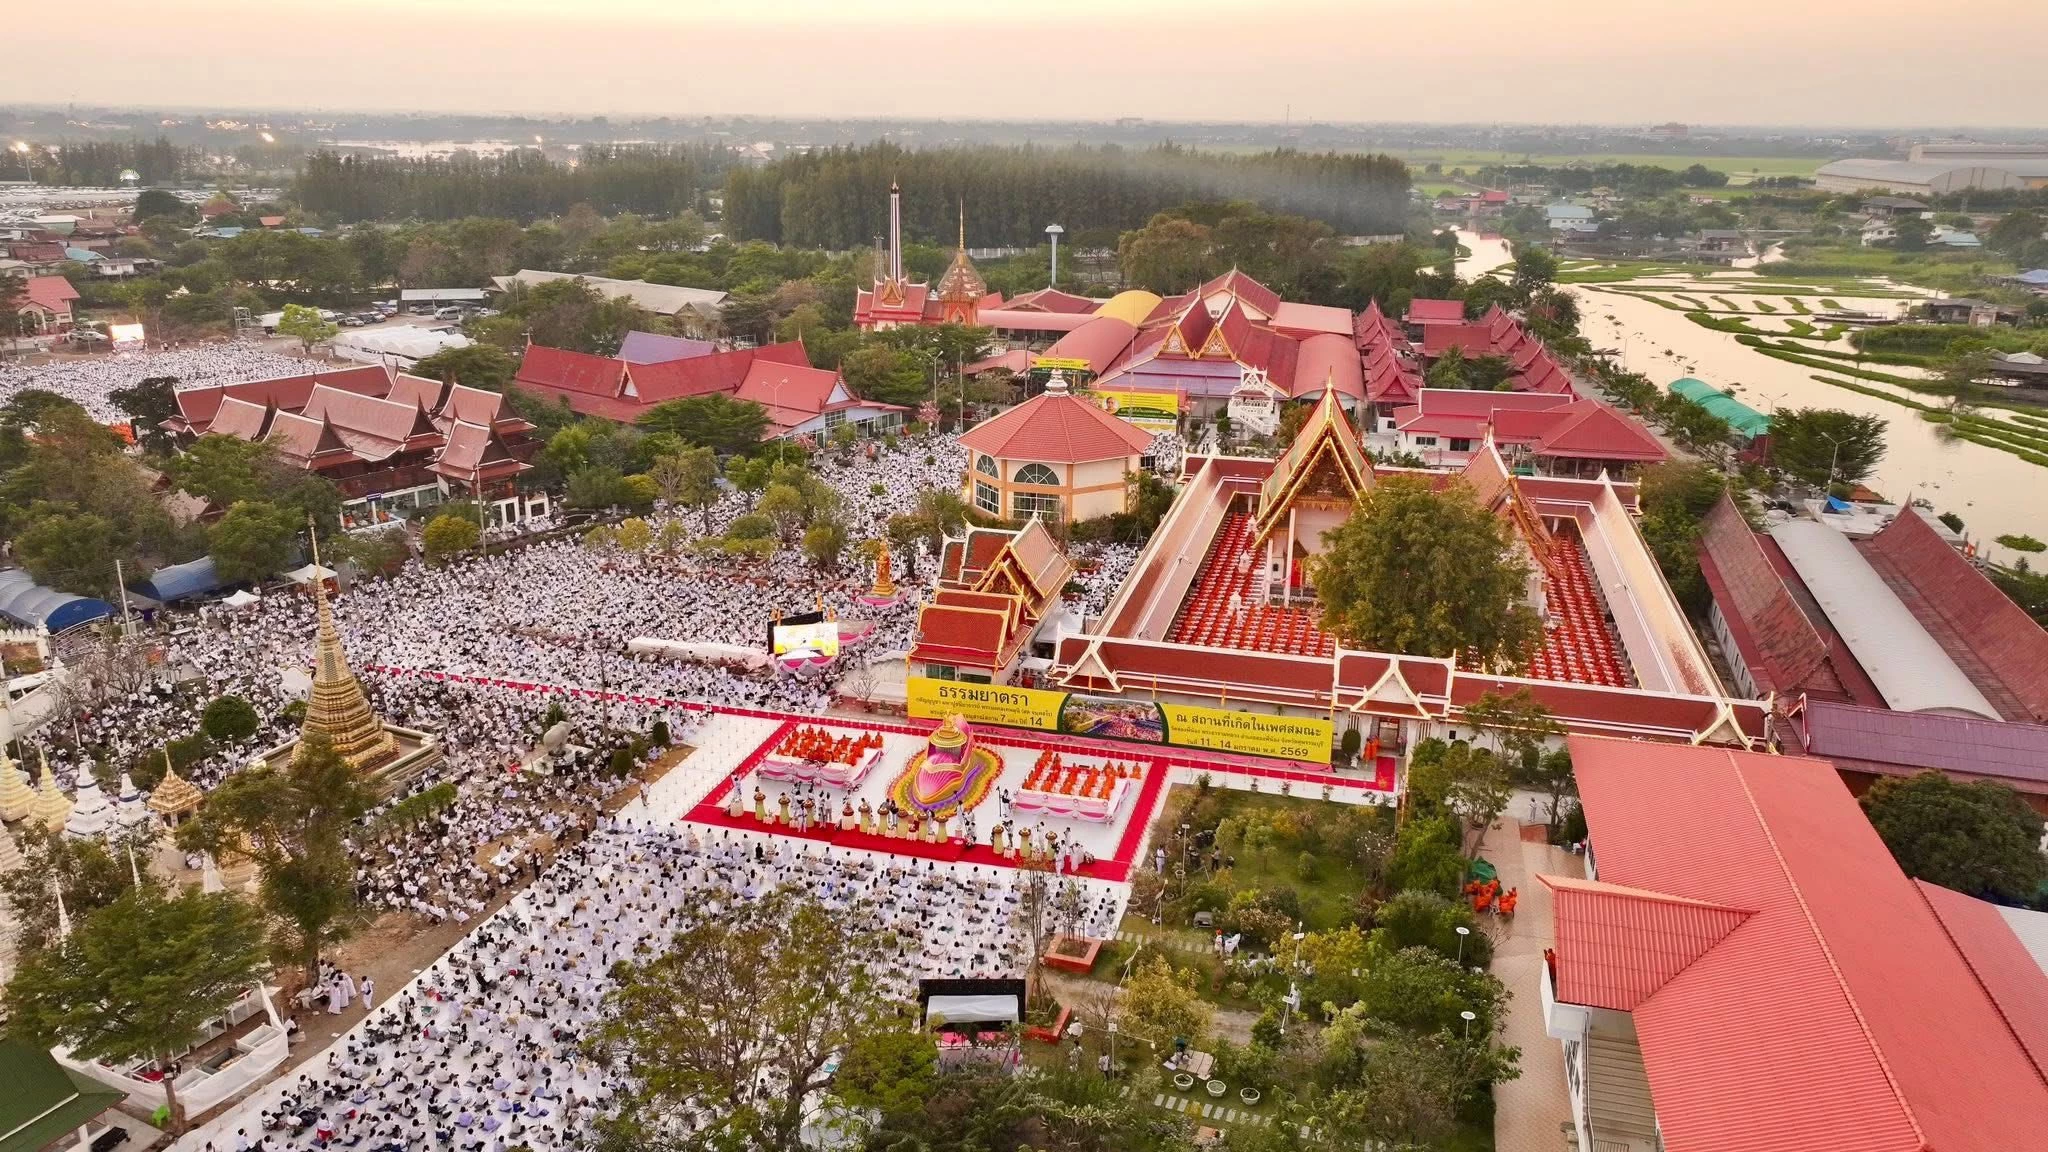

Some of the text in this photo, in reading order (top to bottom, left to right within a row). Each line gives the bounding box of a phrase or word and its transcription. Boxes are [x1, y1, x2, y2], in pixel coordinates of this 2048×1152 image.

[939, 685, 1028, 706] ธรรมยาตรา
[1000, 714, 1006, 722] 7
[1030, 717, 1042, 727] 14
[1176, 713, 1322, 737] ณ สถานที่เกิดในเพศสมณะ
[1200, 737, 1210, 747] 11
[1220, 740, 1231, 749] 14
[1280, 746, 1308, 757] 2569
